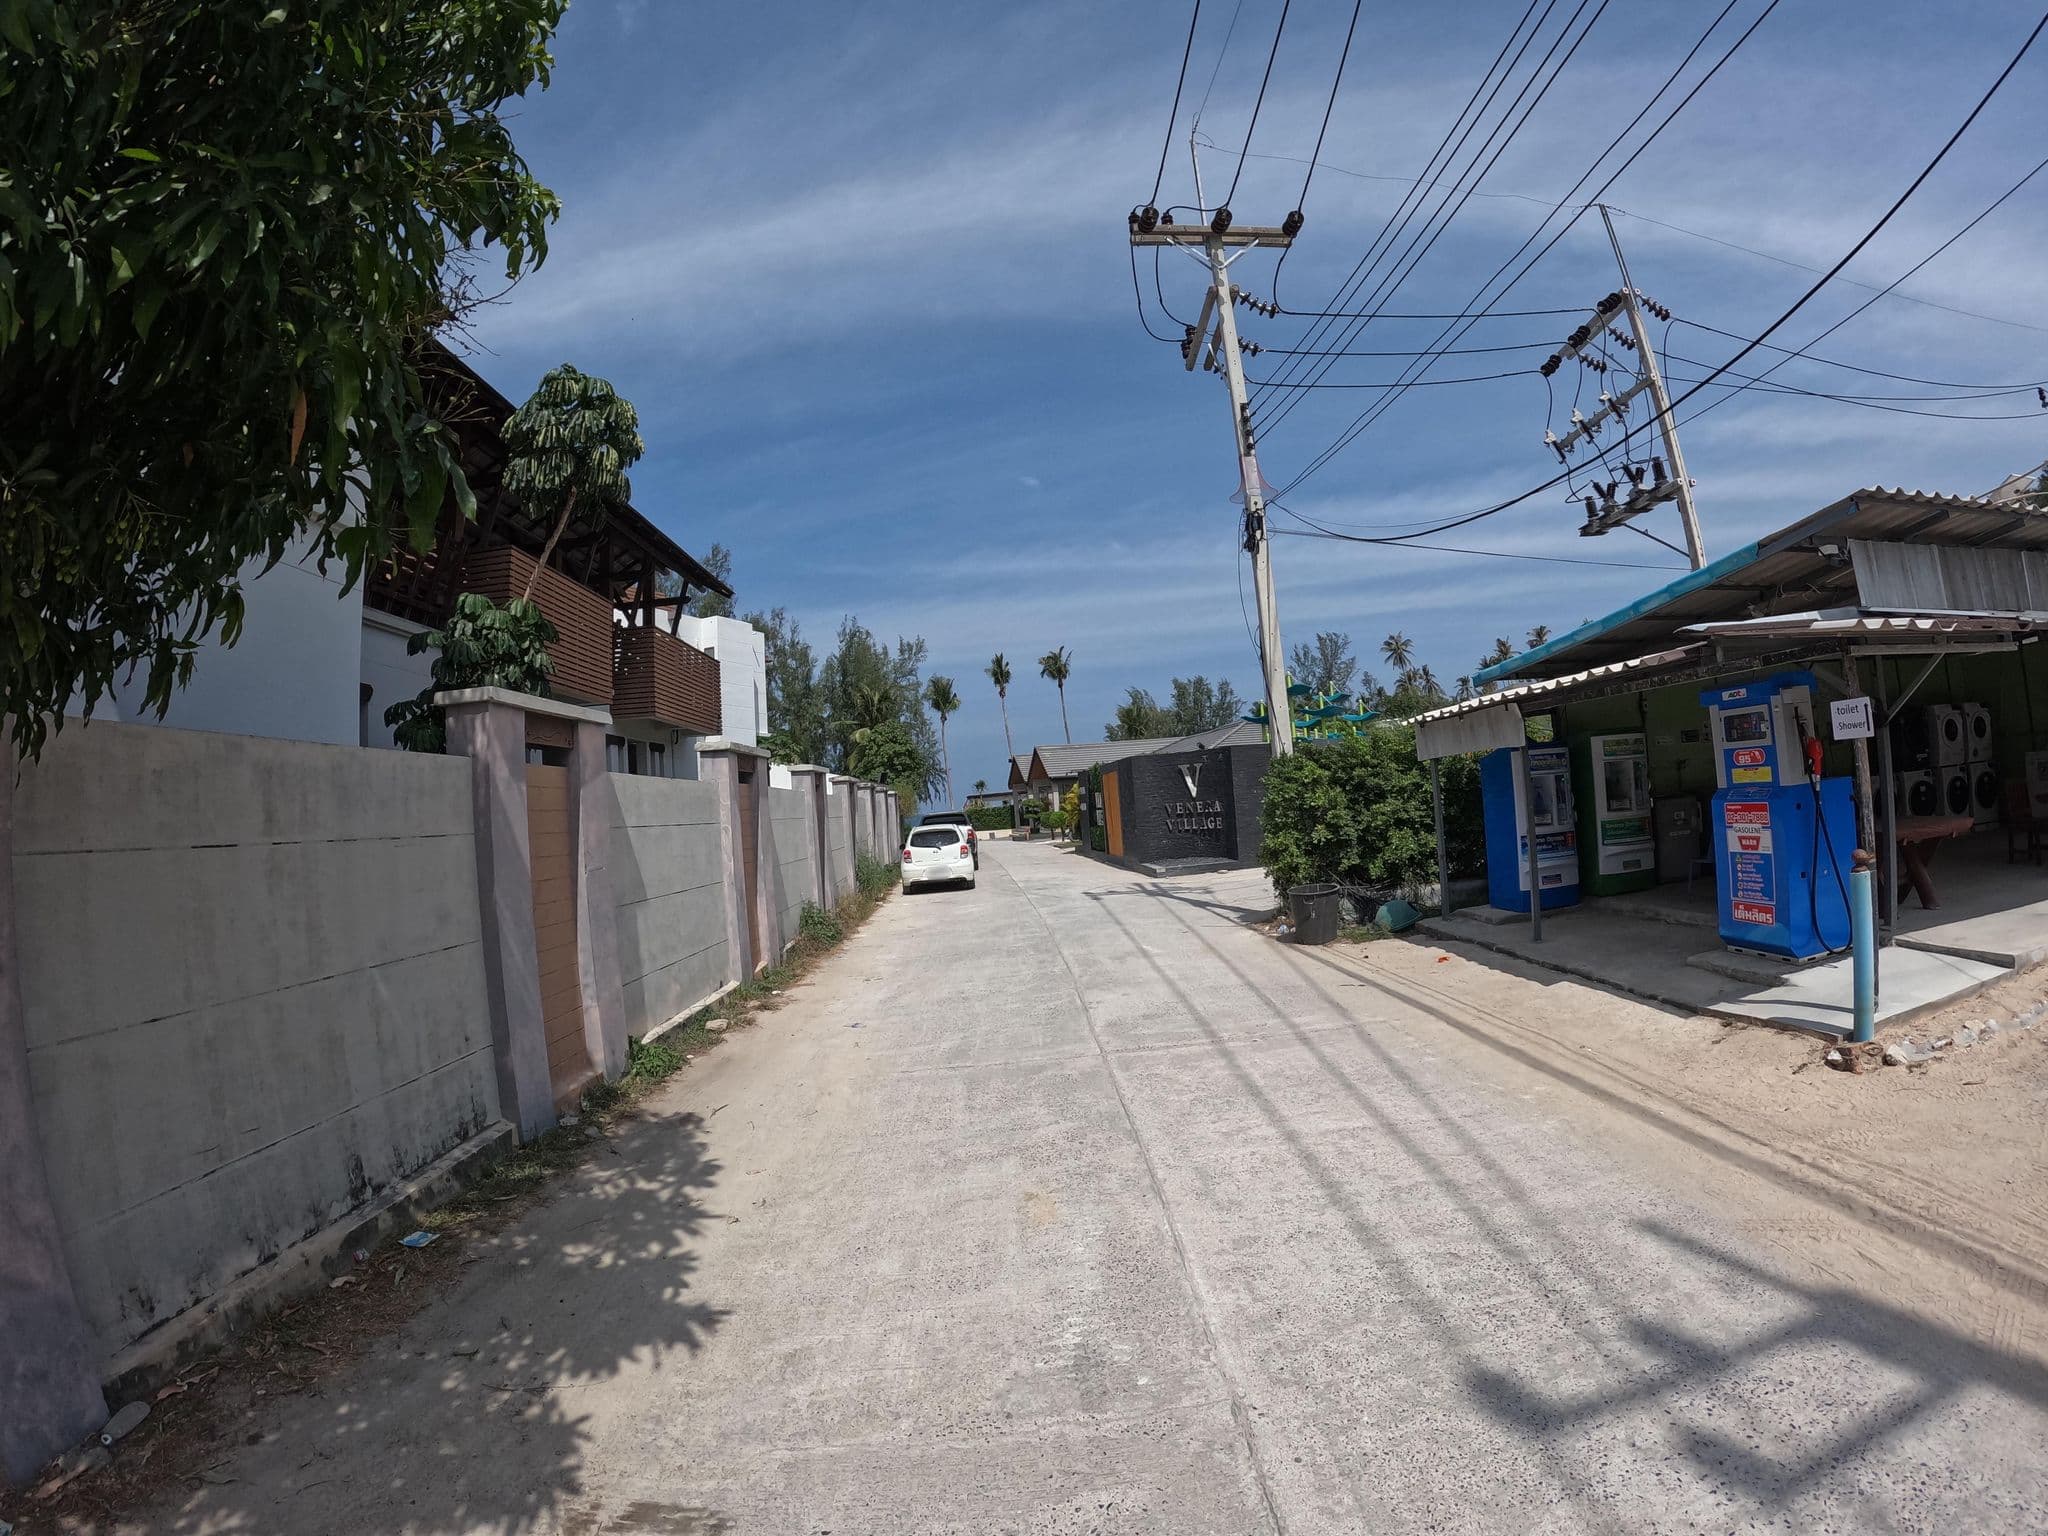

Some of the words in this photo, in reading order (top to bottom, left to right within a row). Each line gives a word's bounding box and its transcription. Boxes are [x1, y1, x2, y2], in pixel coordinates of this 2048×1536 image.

[1739, 754, 1752, 764] 95
[1178, 763, 1203, 798] V
[1166, 817, 1223, 832] VILLAGE
